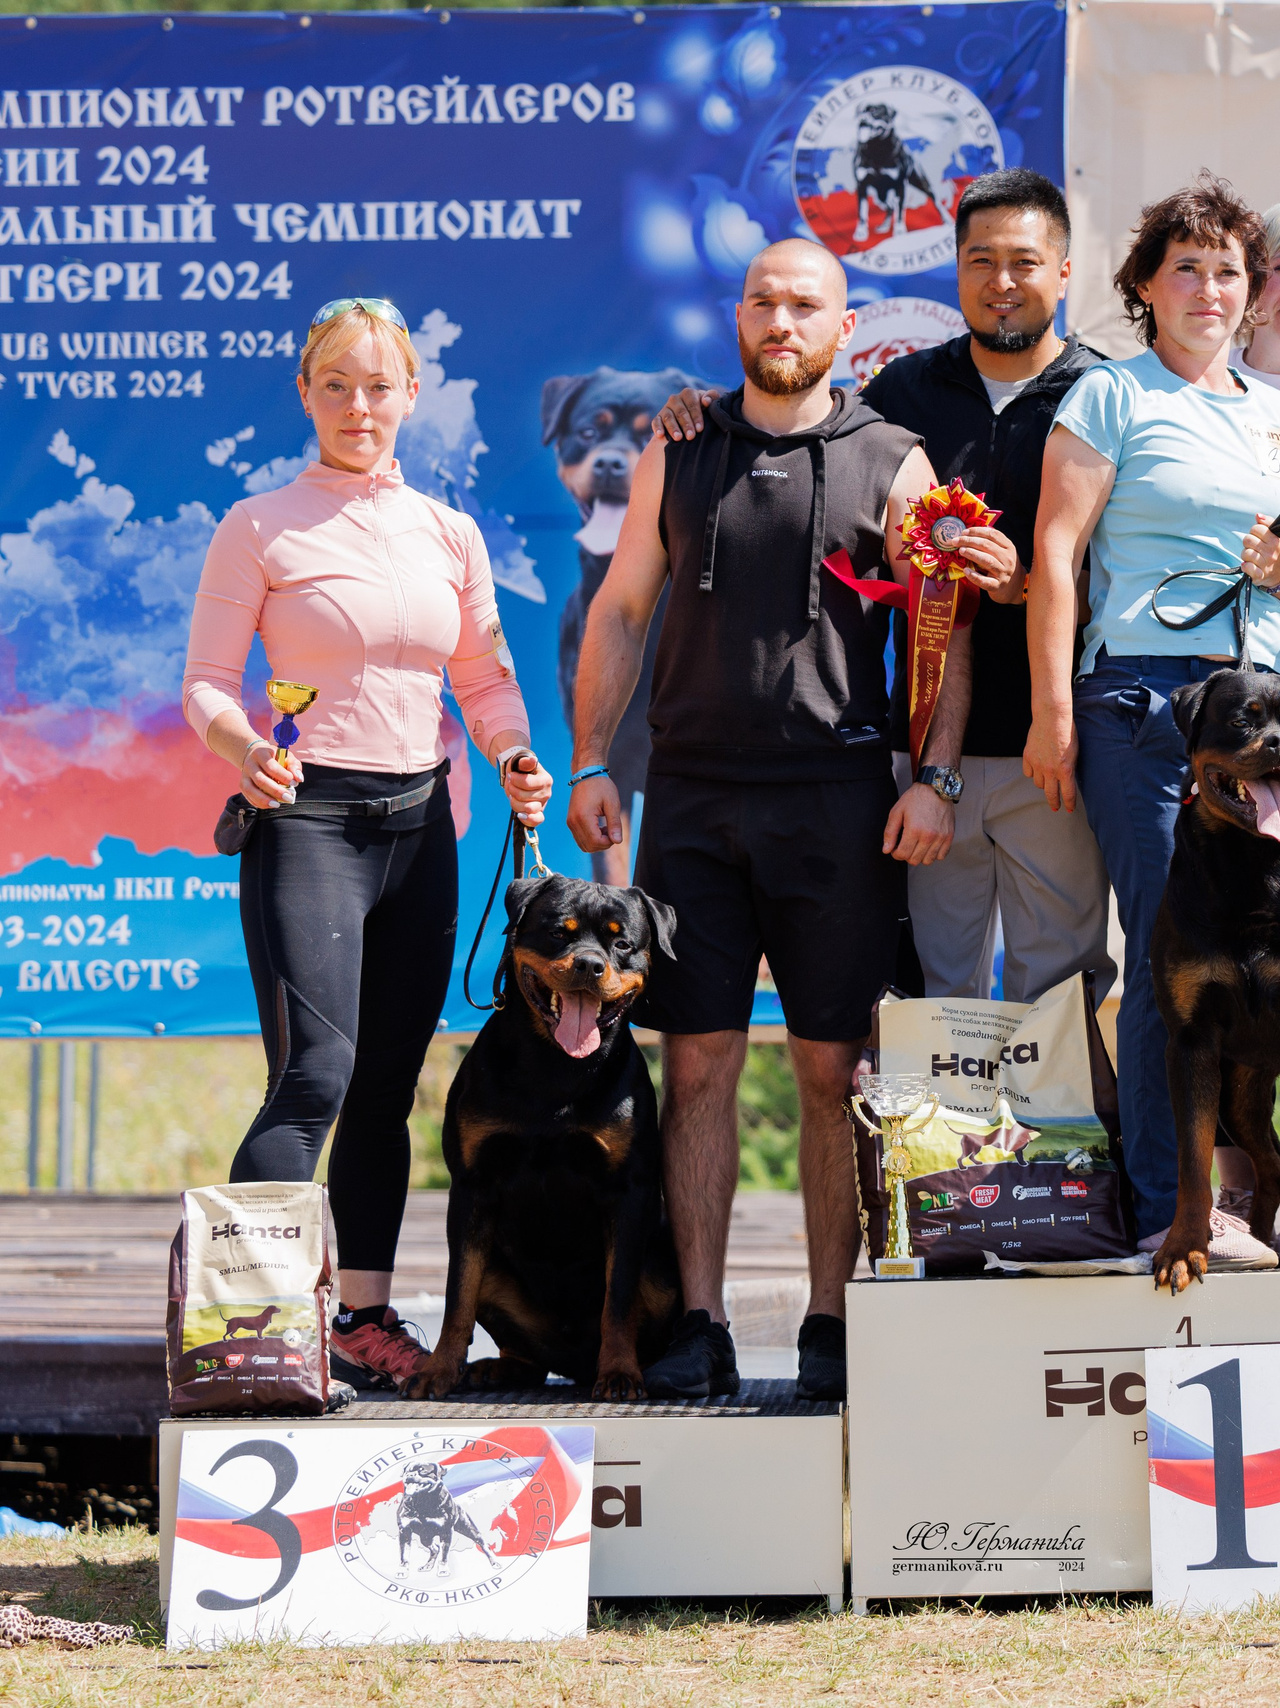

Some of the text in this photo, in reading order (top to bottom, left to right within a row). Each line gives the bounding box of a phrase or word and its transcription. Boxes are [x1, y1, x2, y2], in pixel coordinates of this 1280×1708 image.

[262, 76, 635, 126] РОТВЕЙЛЕРОВ
[891, 72, 958, 103] КЛУБ
[0, 145, 209, 186] ИИ 2024
[233, 199, 581, 242] ЧЕМПИОНАТ
[180, 261, 293, 300] 2024
[59, 331, 208, 360] WINNER
[220, 330, 297, 358] 2024
[17, 370, 118, 399] TVER
[129, 369, 205, 398] 2024
[751, 469, 789, 478] OUTSHOCK
[114, 877, 174, 900] НКП
[16, 958, 200, 992] ВМЕСТЕ
[975, 1196, 992, 1204] MEAT
[211, 1222, 301, 1241] Hanta
[991, 1220, 1012, 1228] OMEGA
[219, 1262, 289, 1277] SMALL/MEDIUM
[1176, 1316, 1201, 1347] 1
[1177, 1358, 1278, 1571] 1
[337, 1441, 424, 1563] РОТВЕЙЛЕР
[442, 1438, 515, 1464] КЛУБ
[519, 1468, 552, 1559] РОССИИ
[196, 1439, 302, 1610] 3
[384, 1576, 503, 1605] РКФ-НКПР
